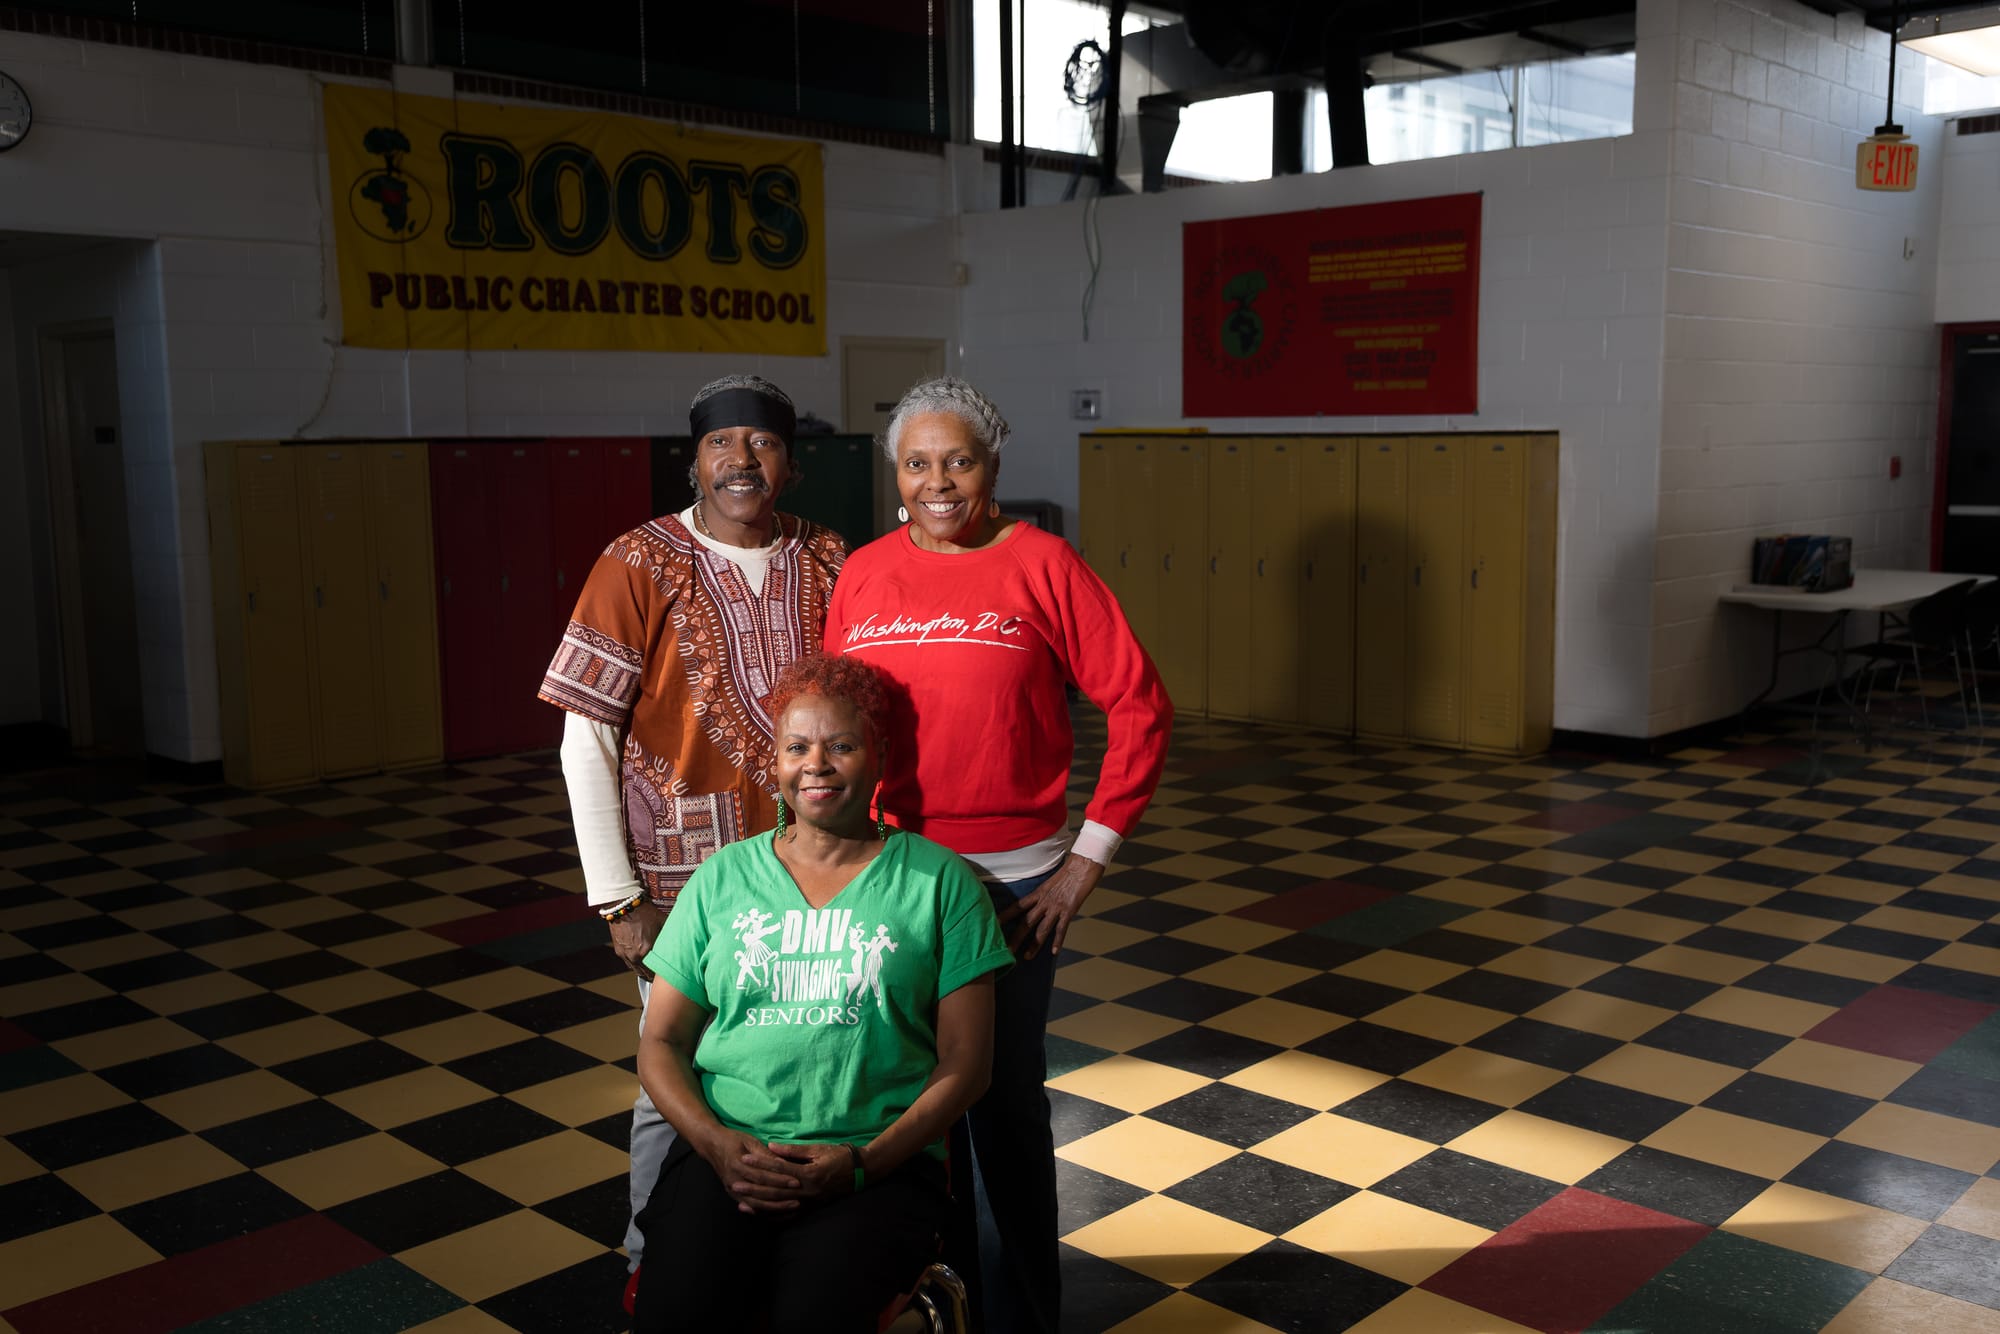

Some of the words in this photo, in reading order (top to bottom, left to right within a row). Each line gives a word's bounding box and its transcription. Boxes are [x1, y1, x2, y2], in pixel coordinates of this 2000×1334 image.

[1873, 144, 1914, 186] EXIT
[440, 131, 808, 270] ROOTS
[368, 271, 513, 311] PUBLIC
[520, 277, 682, 316] CHARTER
[690, 285, 815, 325] SCHOOL
[846, 612, 969, 646] Washington,
[972, 612, 1022, 636] D.C.
[780, 909, 853, 954] DMV
[771, 958, 842, 1003] SWINGING
[744, 1006, 860, 1027] SENIORS
